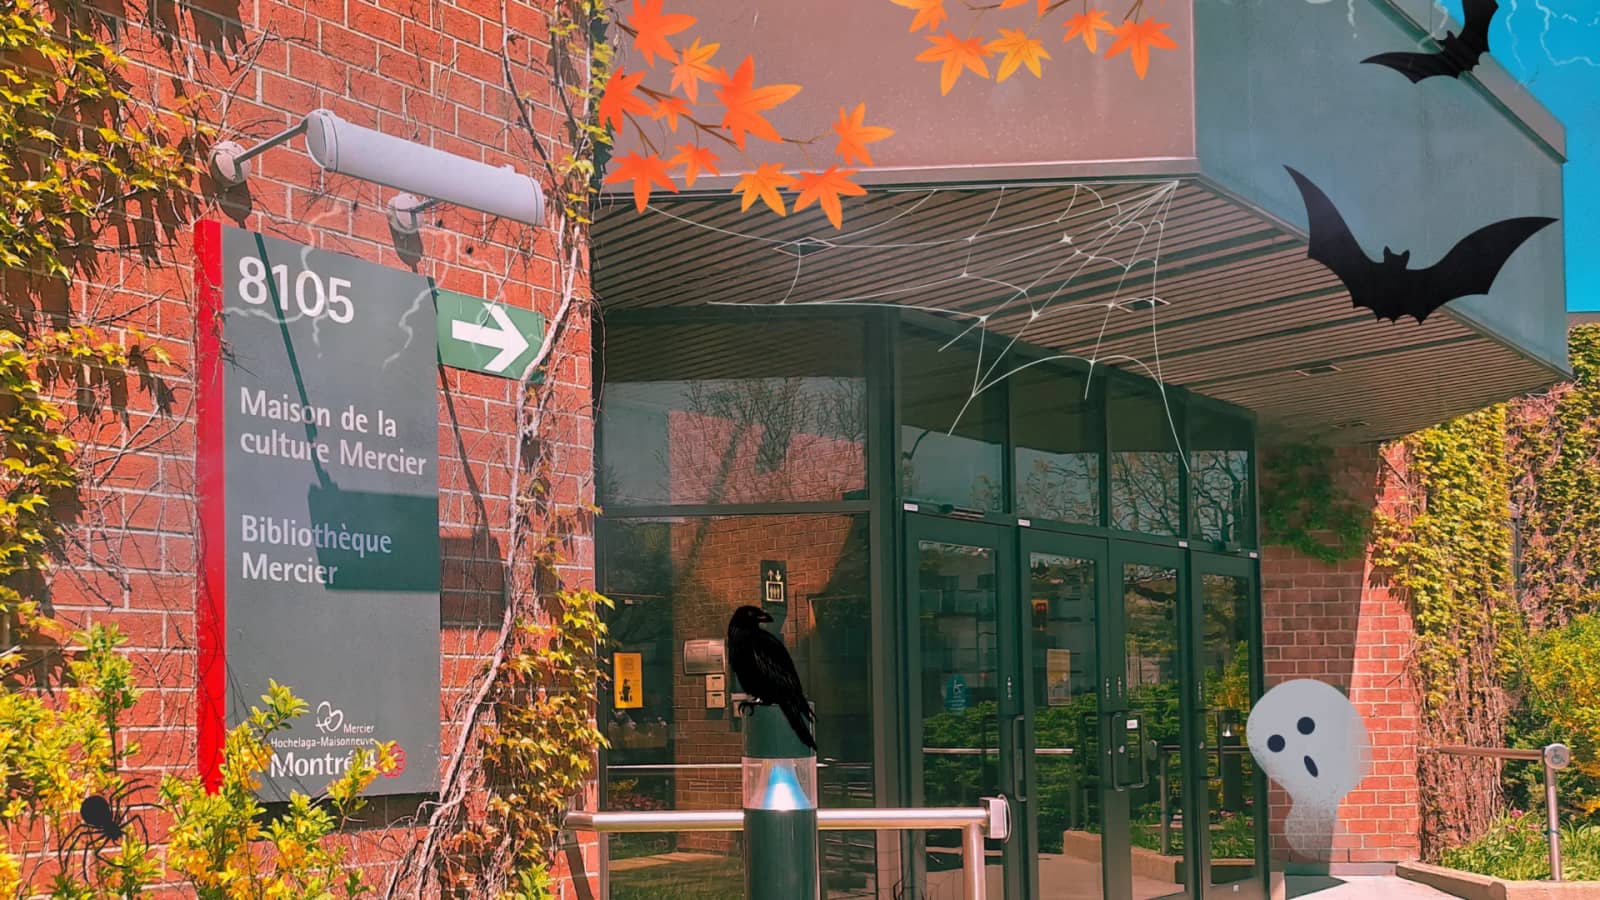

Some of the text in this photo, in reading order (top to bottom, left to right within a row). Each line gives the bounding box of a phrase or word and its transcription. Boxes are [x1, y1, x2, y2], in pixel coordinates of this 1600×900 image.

[238, 256, 354, 324] 8105
[240, 386, 397, 439] Maison de la
[240, 429, 427, 477] culture Mercier
[241, 514, 393, 558] Bibliothèque
[241, 552, 338, 585] Mercier
[271, 736, 375, 749] Hochelaga-Maisonneuve
[343, 723, 374, 733] Mercier
